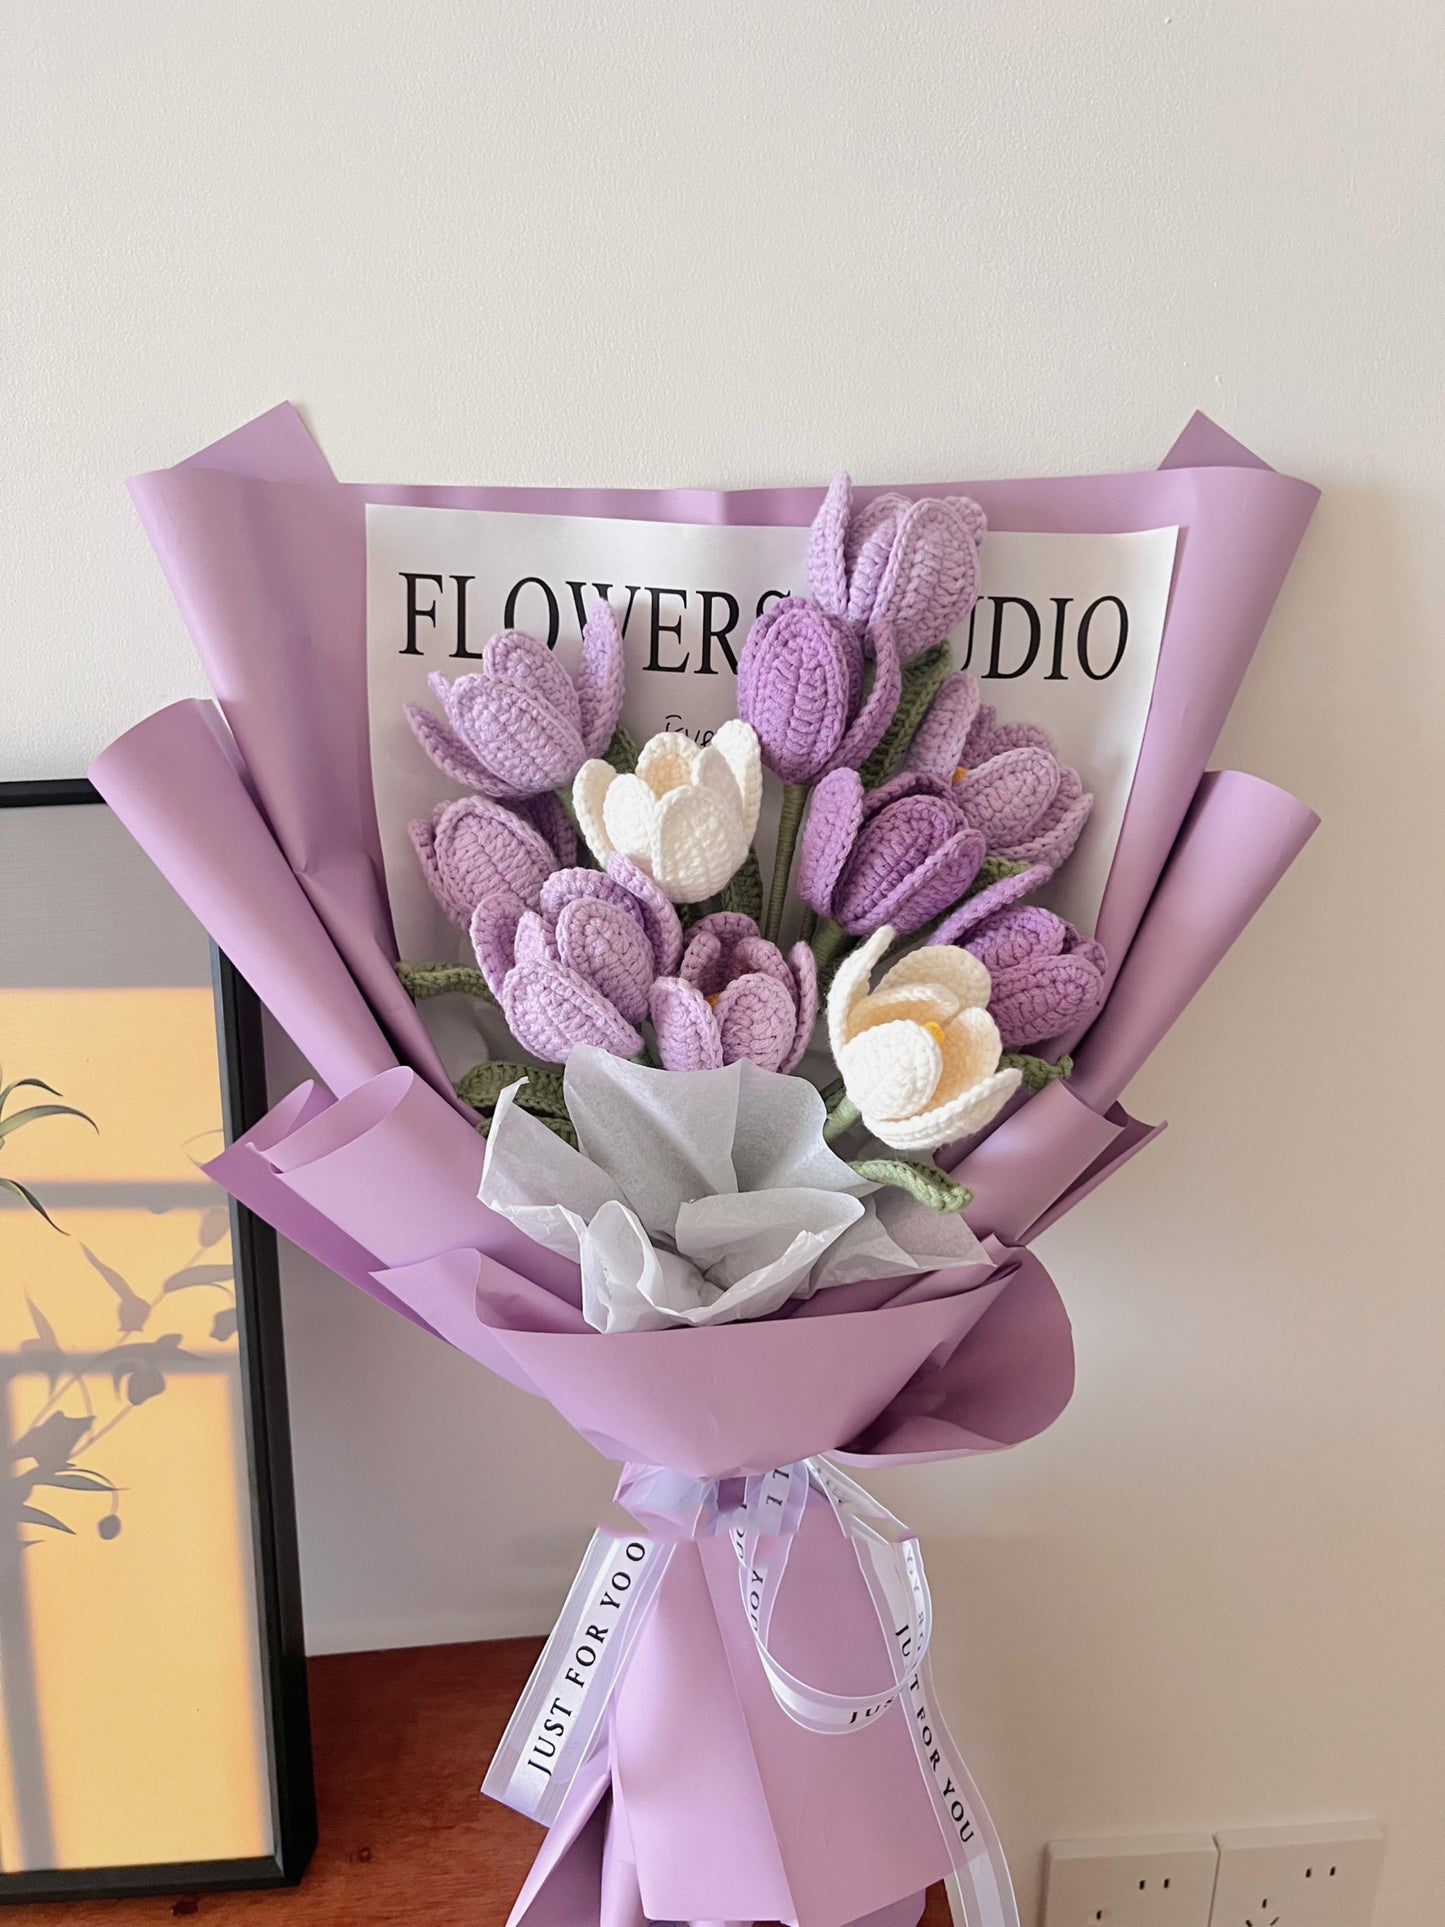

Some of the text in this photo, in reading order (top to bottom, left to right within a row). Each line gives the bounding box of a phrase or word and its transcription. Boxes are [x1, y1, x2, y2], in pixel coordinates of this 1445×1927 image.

[398, 571, 791, 675] FLOWER
[527, 1697, 572, 1776] JUST
[565, 1624, 609, 1688] FOR
[895, 1624, 920, 1691] JUT
[916, 1706, 941, 1772] FOR
[942, 1777, 975, 1843] YOU
